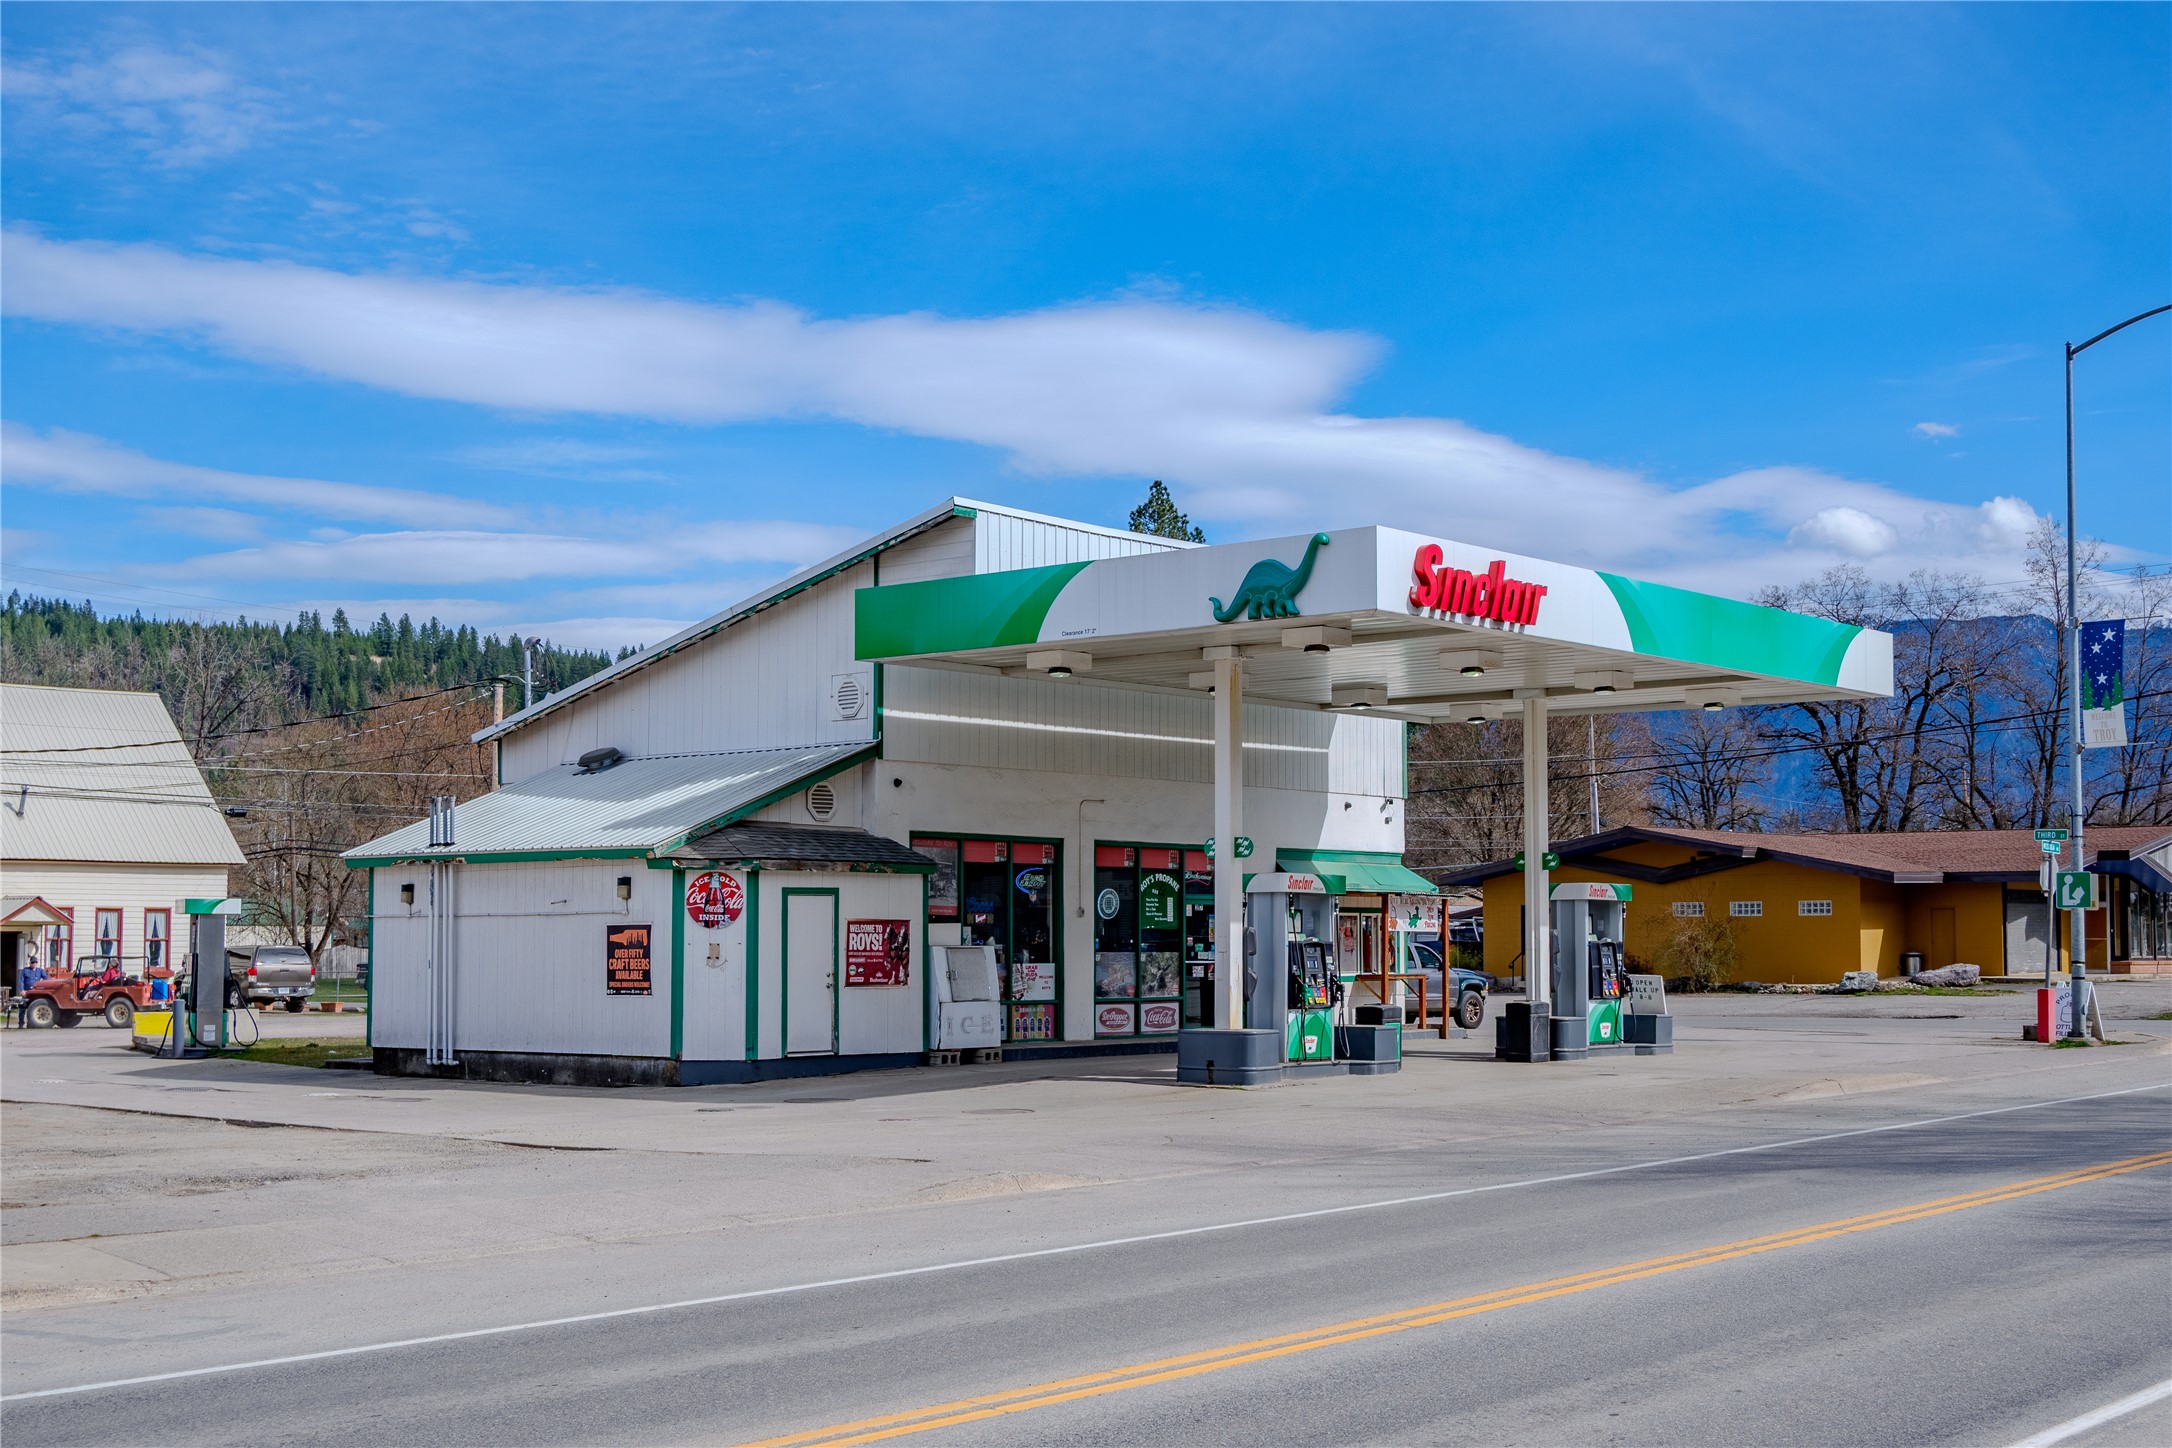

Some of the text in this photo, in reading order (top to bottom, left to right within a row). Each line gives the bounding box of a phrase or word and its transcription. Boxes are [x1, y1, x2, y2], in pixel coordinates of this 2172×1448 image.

[1410, 543, 1548, 625] Sinclair
[2090, 712, 2117, 721] WELCOME
[2101, 721, 2108, 729] TO
[2093, 728, 2117, 741] TROY
[694, 875, 737, 887] ICE COLD
[1140, 873, 1180, 892] ROY'S PROPANE
[1287, 874, 1314, 890] Sinclair
[1589, 884, 1608, 898] Sinclair
[849, 924, 883, 933] WELCOME TO
[849, 933, 883, 951] ROYS!
[615, 949, 644, 958] OVER FIFTY
[609, 958, 650, 970] CRAFT BEERS
[615, 970, 643, 980] AVAILABLE
[2056, 992, 2072, 1005] PRO
